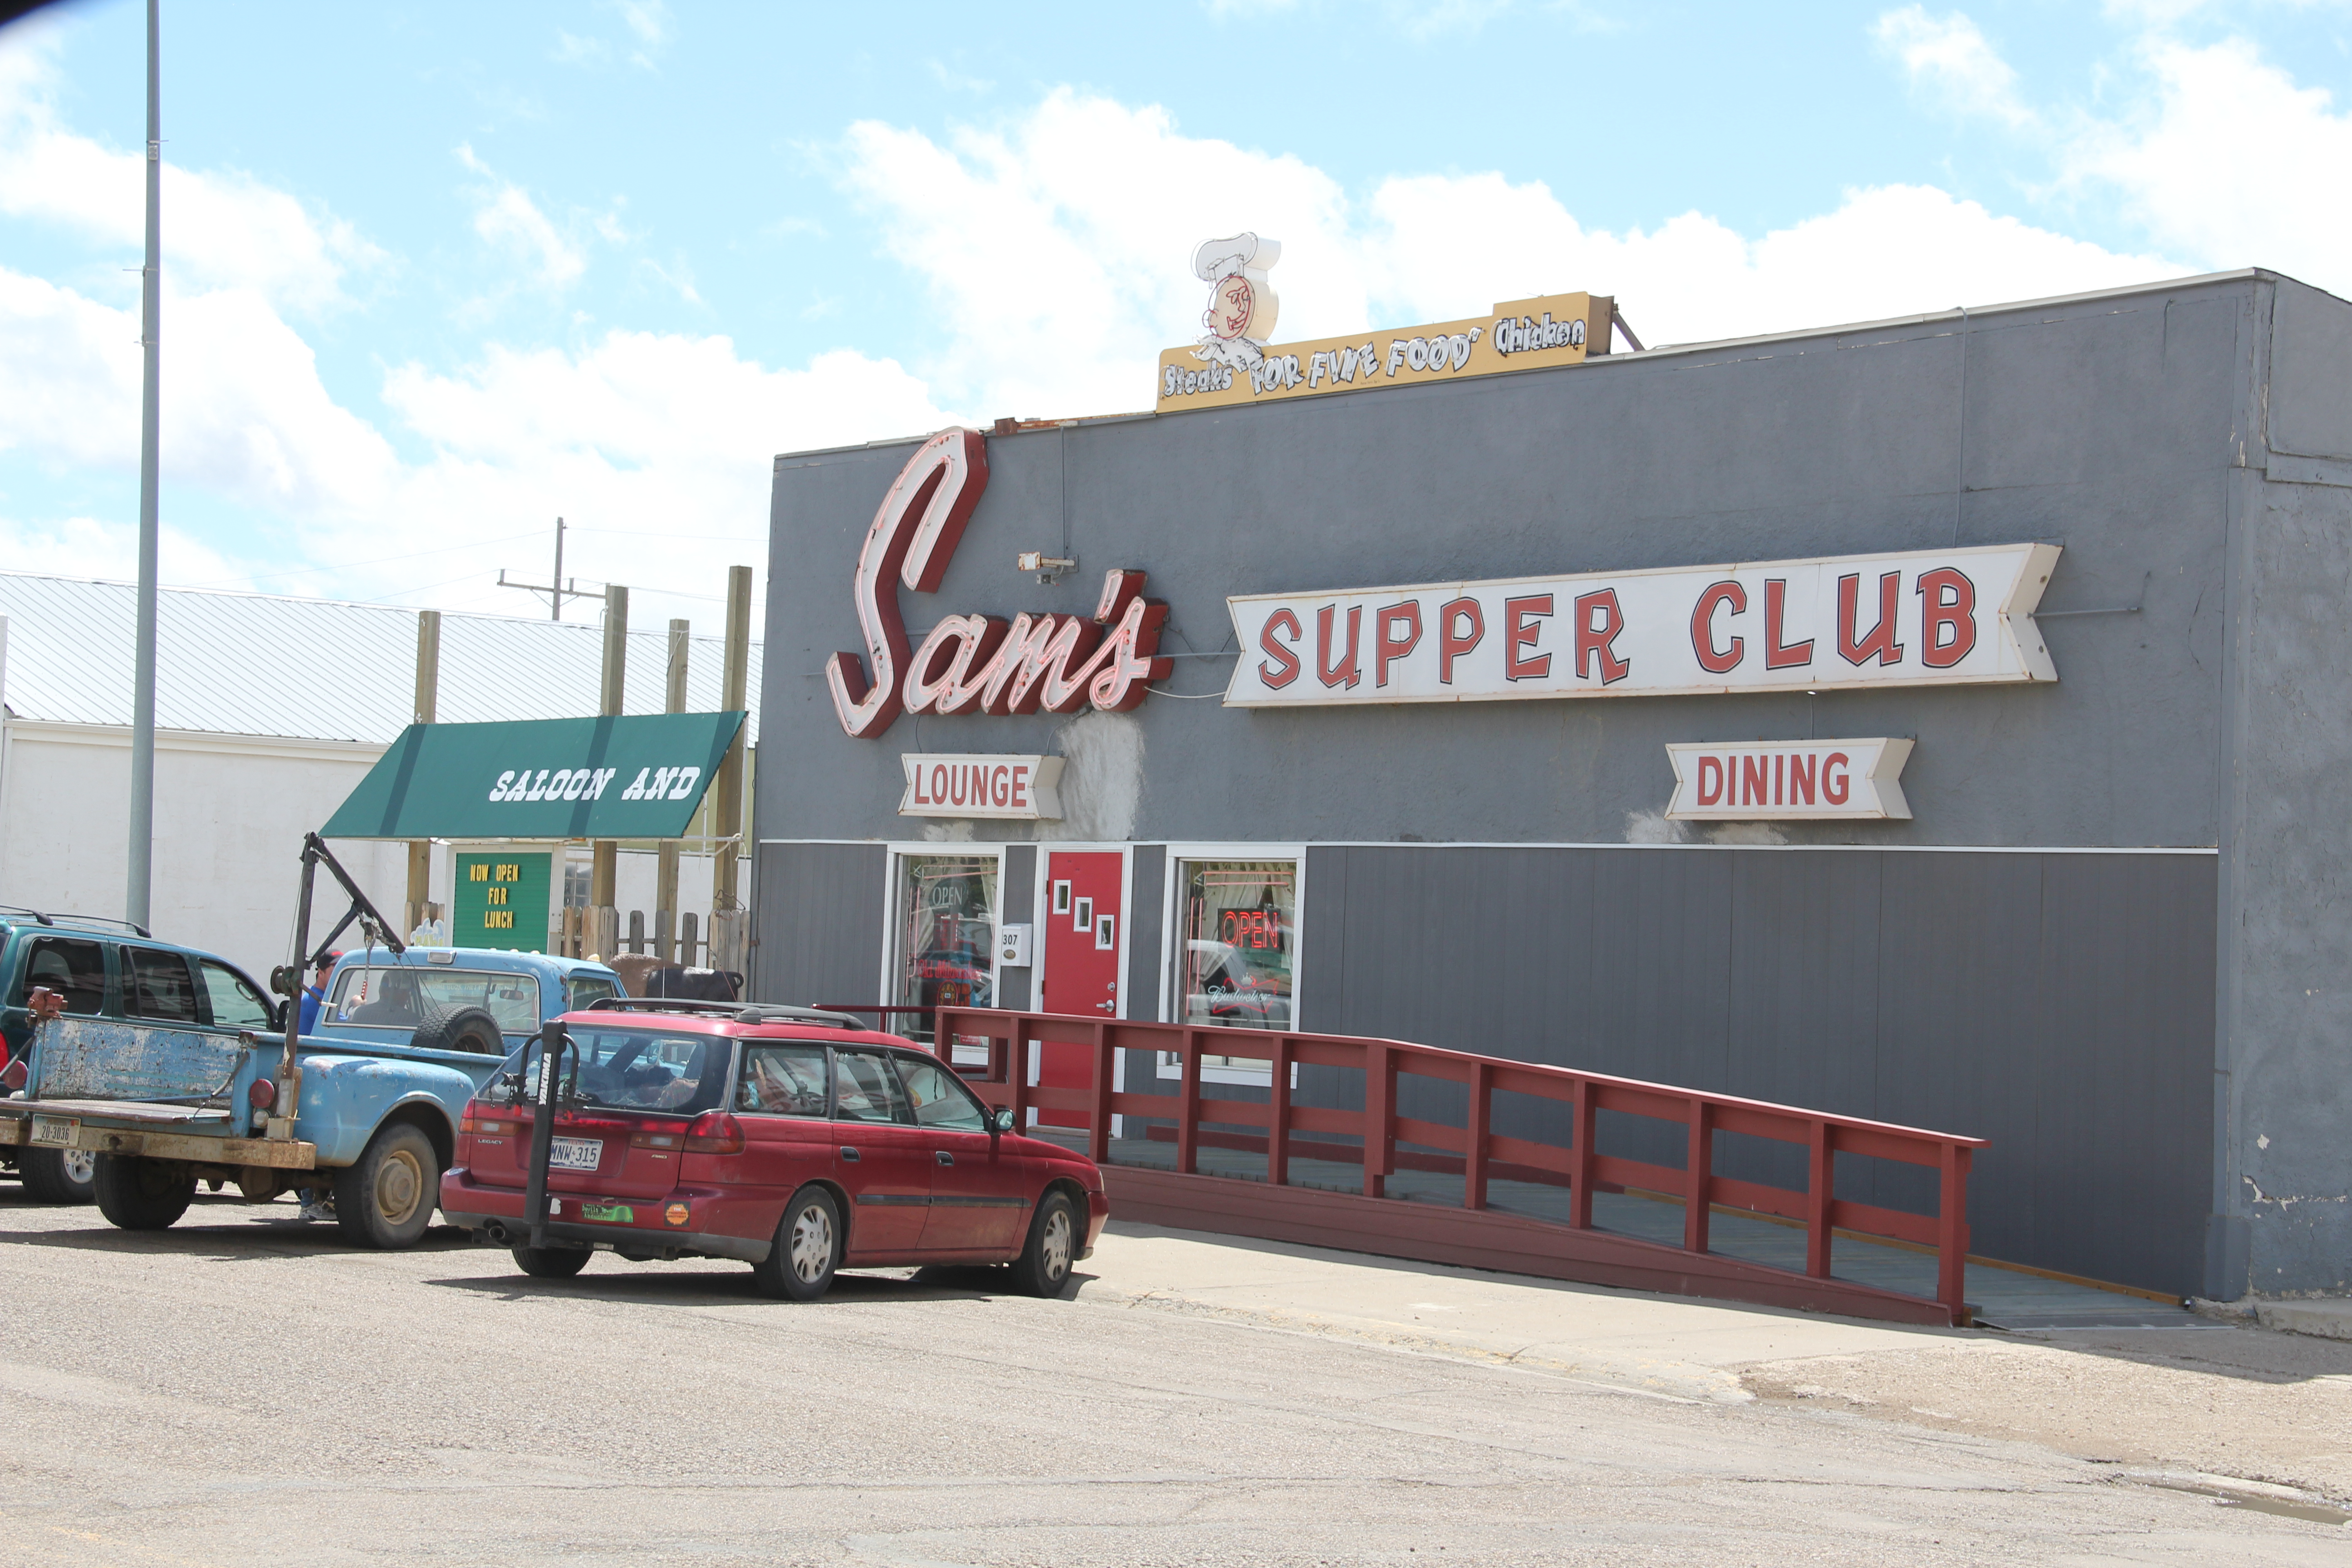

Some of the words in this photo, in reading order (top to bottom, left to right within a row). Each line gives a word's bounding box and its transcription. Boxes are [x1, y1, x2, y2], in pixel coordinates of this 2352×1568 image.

[1492, 312, 1586, 353] Chicken
[1162, 360, 1233, 397] Steaks
[1306, 341, 1380, 389] FINE
[826, 426, 1171, 739] Sam's
[1258, 587, 1631, 691] SUPPER
[1690, 566, 1977, 674] CLUB
[489, 767, 617, 803] SALOON
[621, 765, 701, 801] AND
[914, 764, 1029, 808] LOUNGE
[1696, 752, 1850, 807] DINING
[470, 864, 490, 882] NOW
[495, 864, 519, 882] OPEN
[488, 887, 508, 905] FOR
[932, 886, 963, 906] OPEN
[484, 911, 514, 929] LUNCH
[1221, 911, 1278, 948] OPEN
[1003, 934, 1018, 946] 307
[1208, 985, 1271, 1003] Budweiser
[538, 1053, 552, 1106] YAKIMA
